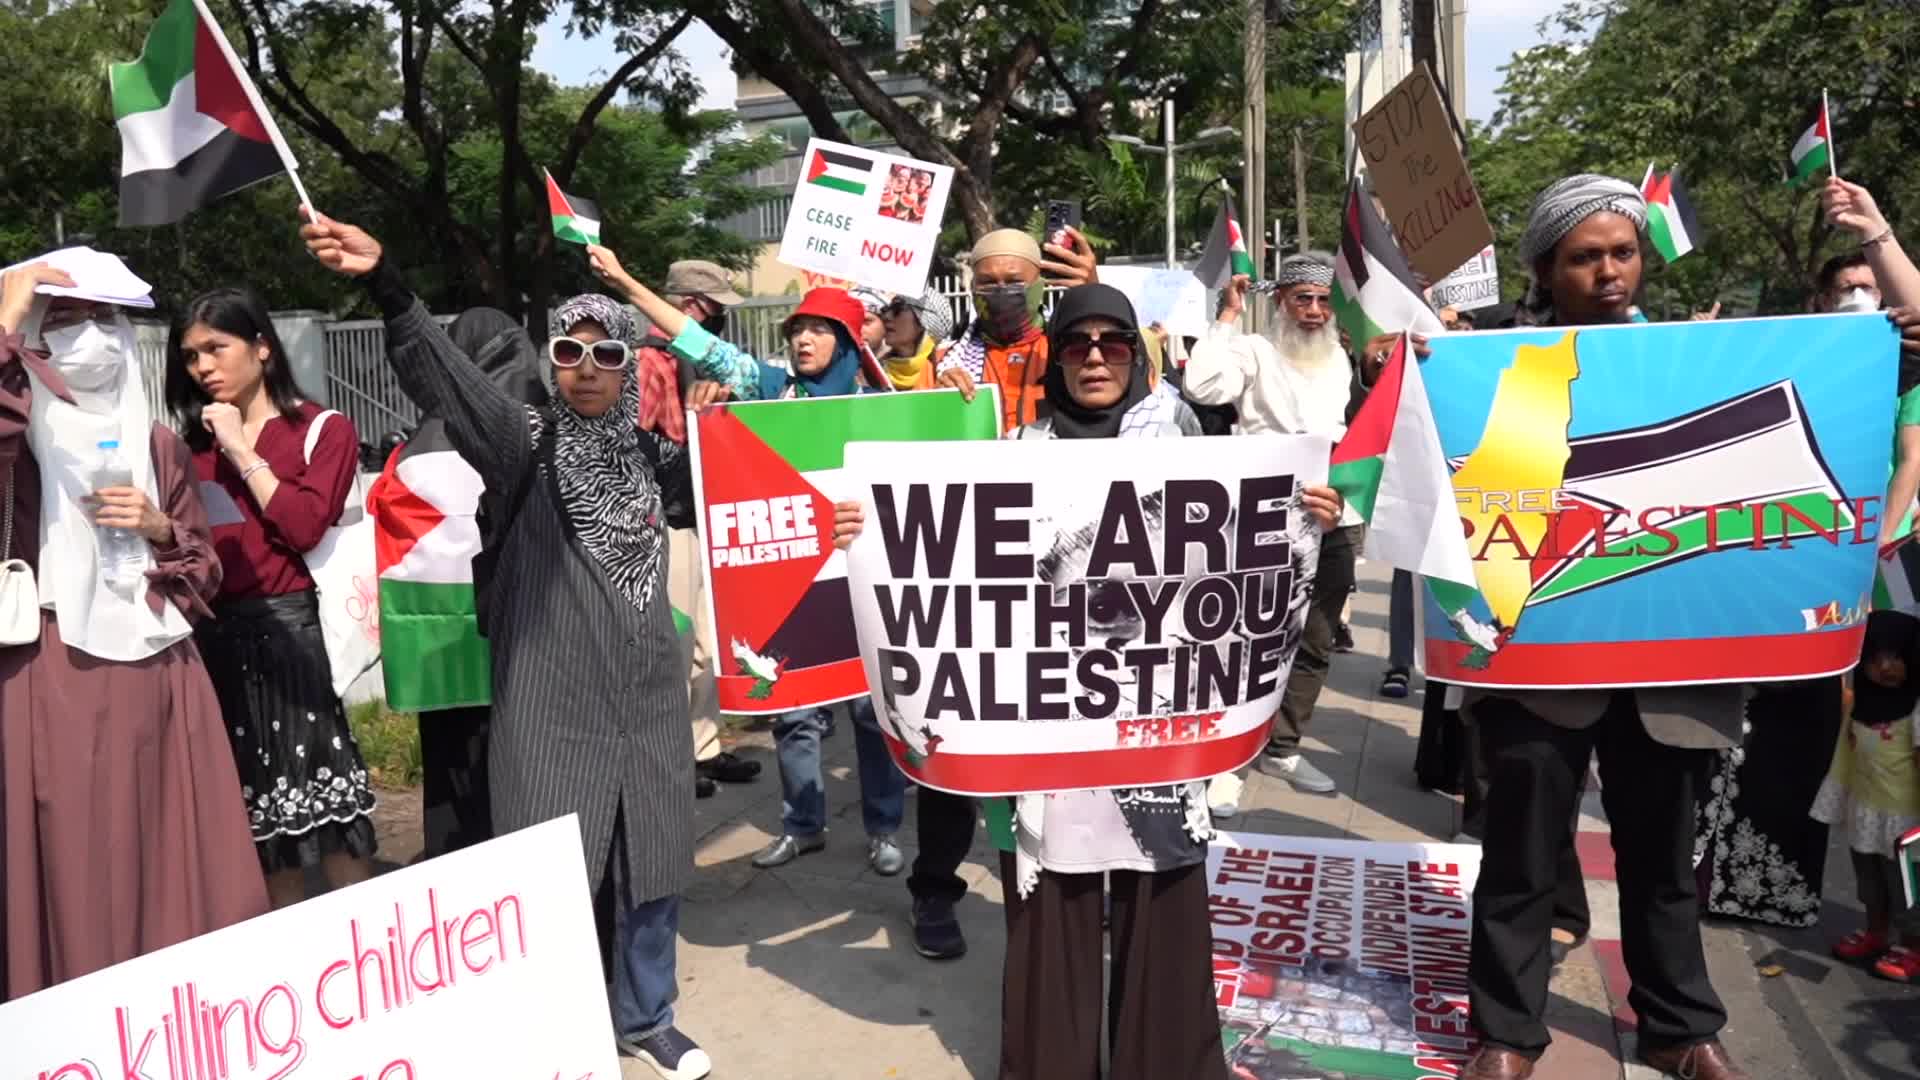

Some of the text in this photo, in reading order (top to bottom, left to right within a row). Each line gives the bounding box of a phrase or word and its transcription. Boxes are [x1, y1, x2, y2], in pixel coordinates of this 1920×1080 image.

[1362, 75, 1430, 163] STOP
[806, 207, 854, 231] CEASE
[806, 236, 839, 257] FIRE
[1398, 173, 1477, 252] KILLING
[861, 239, 914, 267] NOW
[708, 494, 818, 548] FREE
[712, 536, 821, 569] PALESTINE
[871, 474, 1295, 580] WE ARE
[873, 571, 1295, 649] WITH YOU
[876, 631, 1287, 721] PALESTINE
[1116, 711, 1226, 746] FREE
[1215, 847, 1270, 885] THE
[1208, 894, 1255, 926] OF
[1247, 851, 1317, 965] ISRAELI
[1310, 856, 1355, 960] OCCUPATION
[1361, 859, 1409, 974] INDIPENDENT
[114, 888, 527, 1080] killing children
[1407, 861, 1482, 1080] ALESTINIAN STATE
